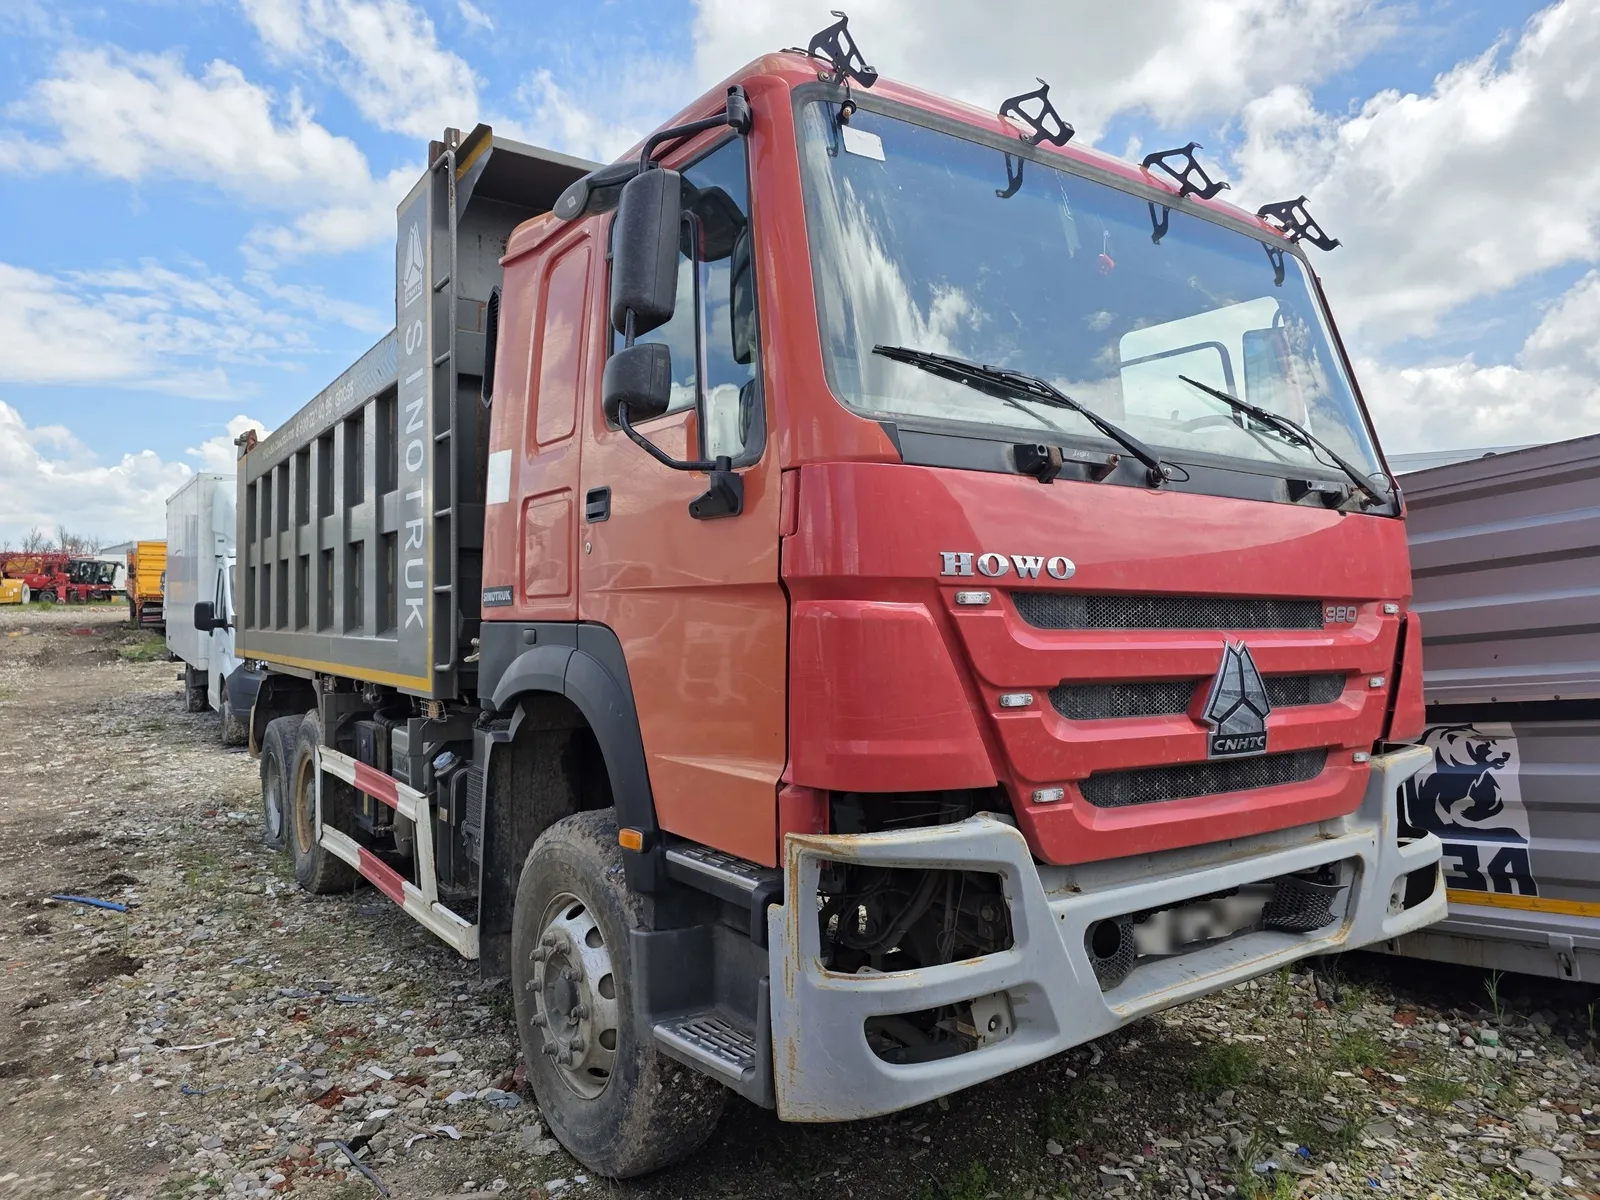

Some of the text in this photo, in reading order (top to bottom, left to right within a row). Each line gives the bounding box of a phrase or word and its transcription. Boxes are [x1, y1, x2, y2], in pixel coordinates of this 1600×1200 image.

[405, 319, 424, 629] SINOTRUK
[939, 551, 1076, 580] HOWO
[1325, 606, 1357, 623] 380
[1213, 735, 1266, 751] CNHTC
